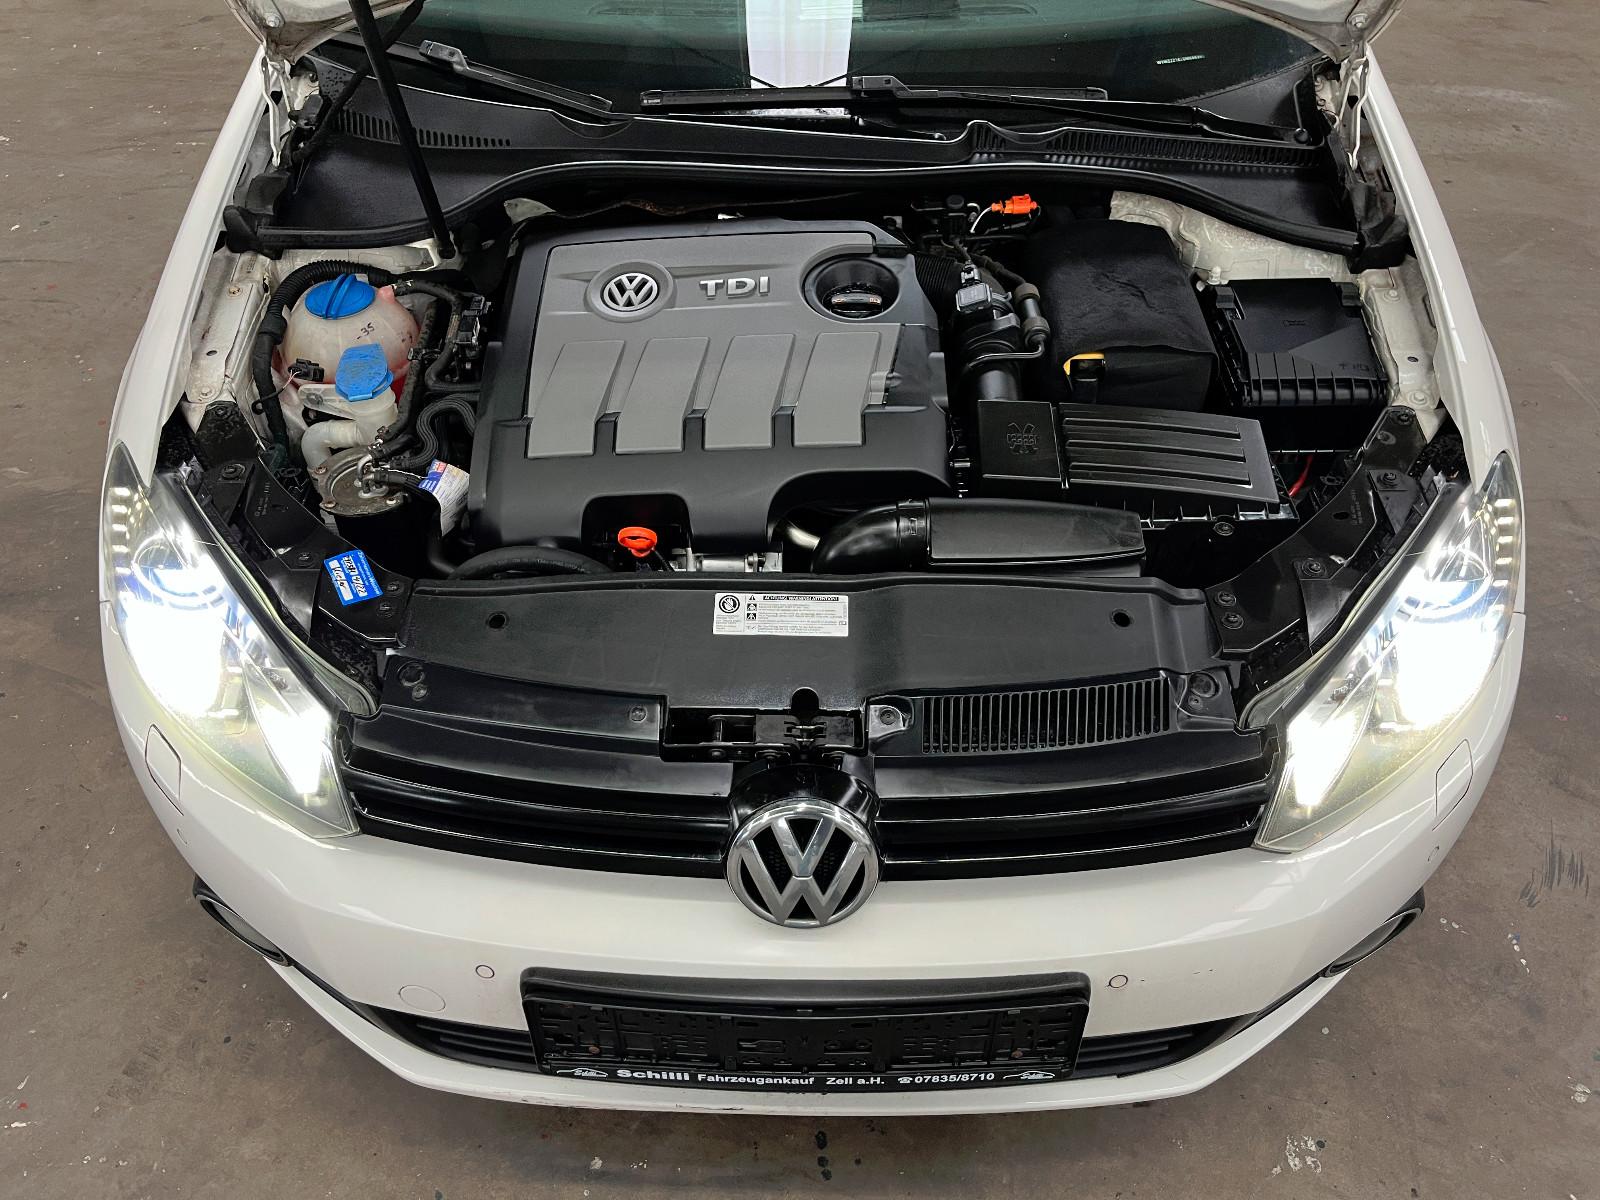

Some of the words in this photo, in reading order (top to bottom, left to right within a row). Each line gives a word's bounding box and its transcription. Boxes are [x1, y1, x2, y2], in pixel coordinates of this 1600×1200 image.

[700, 276, 770, 298] TDI
[730, 800, 876, 927] VW
[616, 1069, 690, 1081] Schilli
[697, 1073, 815, 1085] Fahrzeugankauf
[826, 1077, 853, 1085] Zell
[857, 1077, 885, 1085] a.H.
[914, 1073, 995, 1083] 07835/8710
